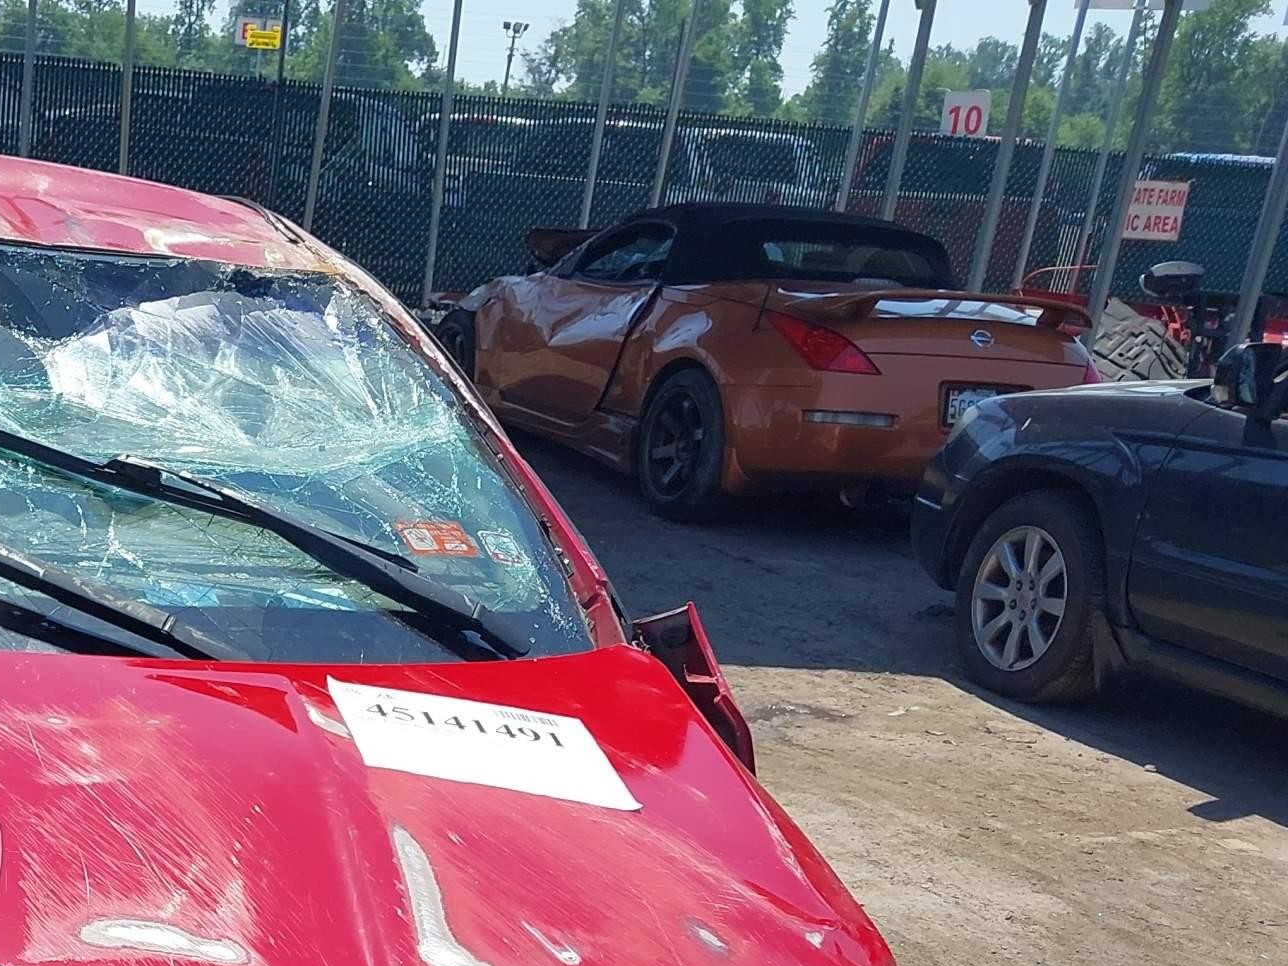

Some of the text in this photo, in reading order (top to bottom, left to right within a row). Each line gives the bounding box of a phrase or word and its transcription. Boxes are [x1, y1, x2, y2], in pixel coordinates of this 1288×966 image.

[949, 105, 982, 135] 10
[1133, 187, 1186, 207] ATE FARM
[1125, 214, 1179, 234] IC AREA
[366, 703, 565, 748] 45141491
